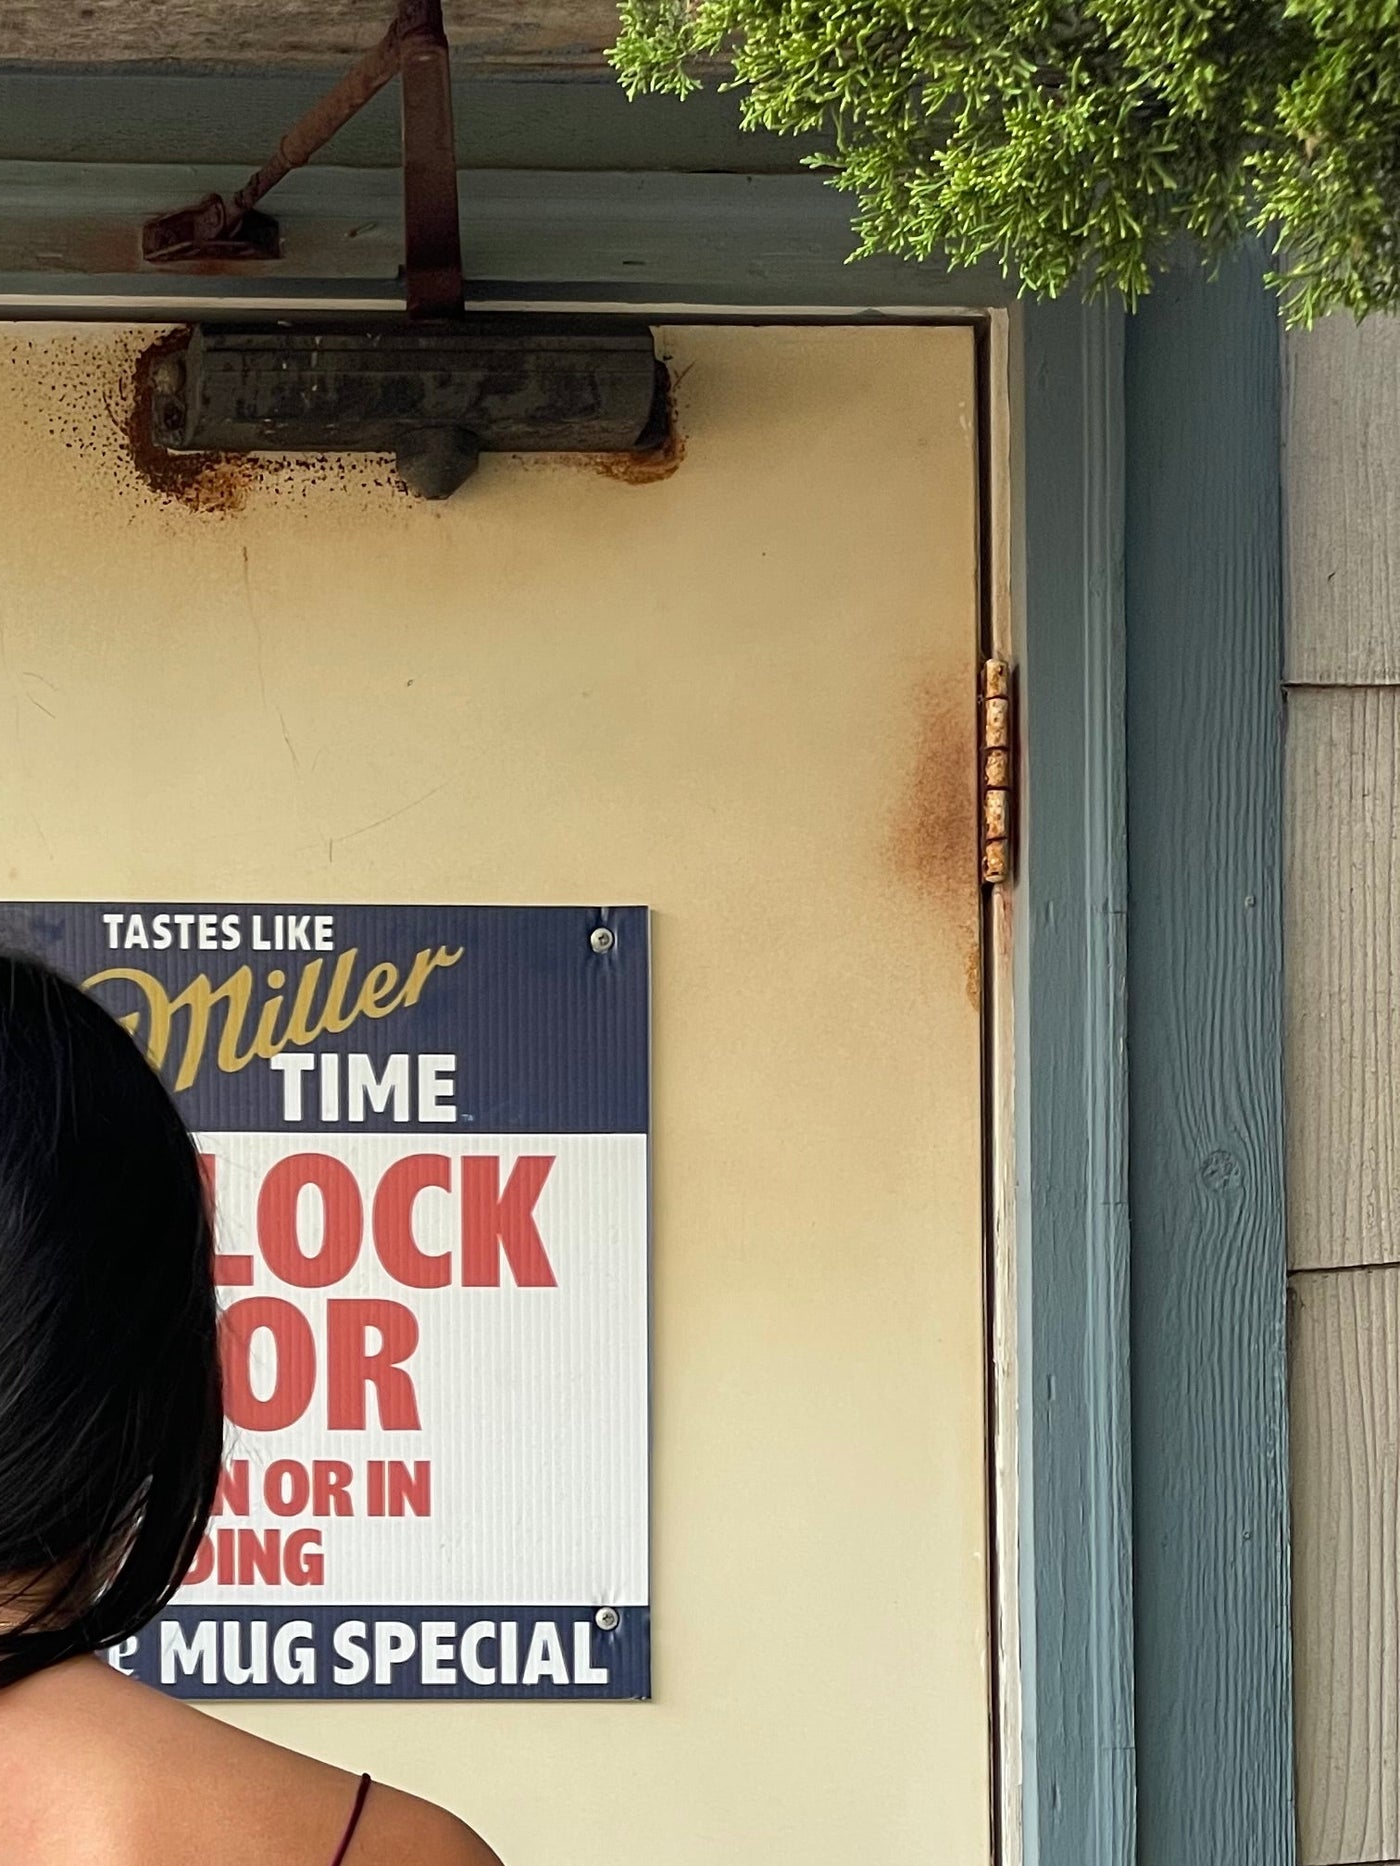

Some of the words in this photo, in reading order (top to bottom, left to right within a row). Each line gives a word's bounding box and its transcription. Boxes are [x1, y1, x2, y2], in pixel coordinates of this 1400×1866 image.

[103, 913, 242, 951] TASTES
[252, 914, 334, 951] LIKE
[82, 944, 465, 1092] Miller
[270, 1053, 458, 1123] TIME
[262, 1458, 355, 1517] OR
[366, 1459, 432, 1517] IN
[159, 1620, 317, 1685] MUG
[332, 1620, 610, 1686] SPECIAL
